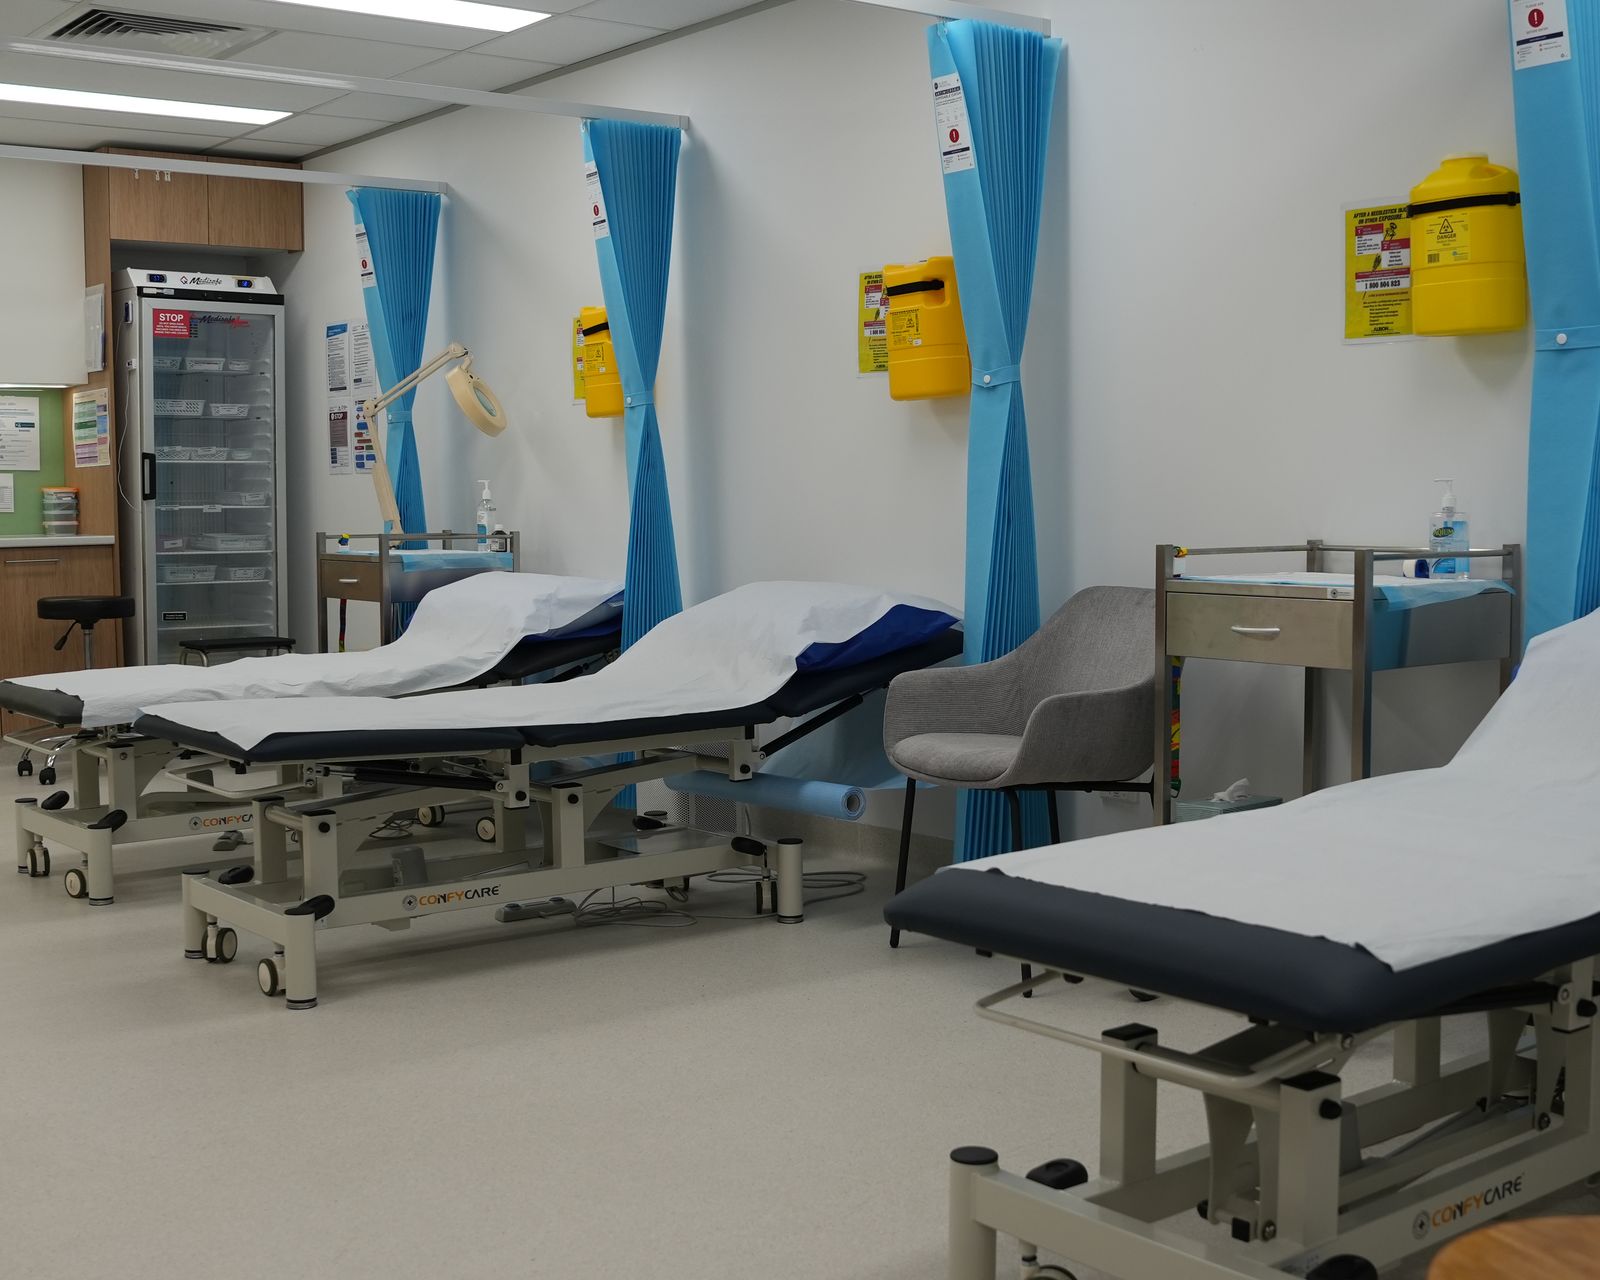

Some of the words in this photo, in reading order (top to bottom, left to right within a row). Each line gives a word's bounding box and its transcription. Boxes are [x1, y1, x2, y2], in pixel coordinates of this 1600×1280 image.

[1436, 232, 1456, 240] DANGER
[189, 276, 222, 286] Medisafe
[159, 313, 184, 322] STOP
[203, 814, 254, 827] CONFYCA
